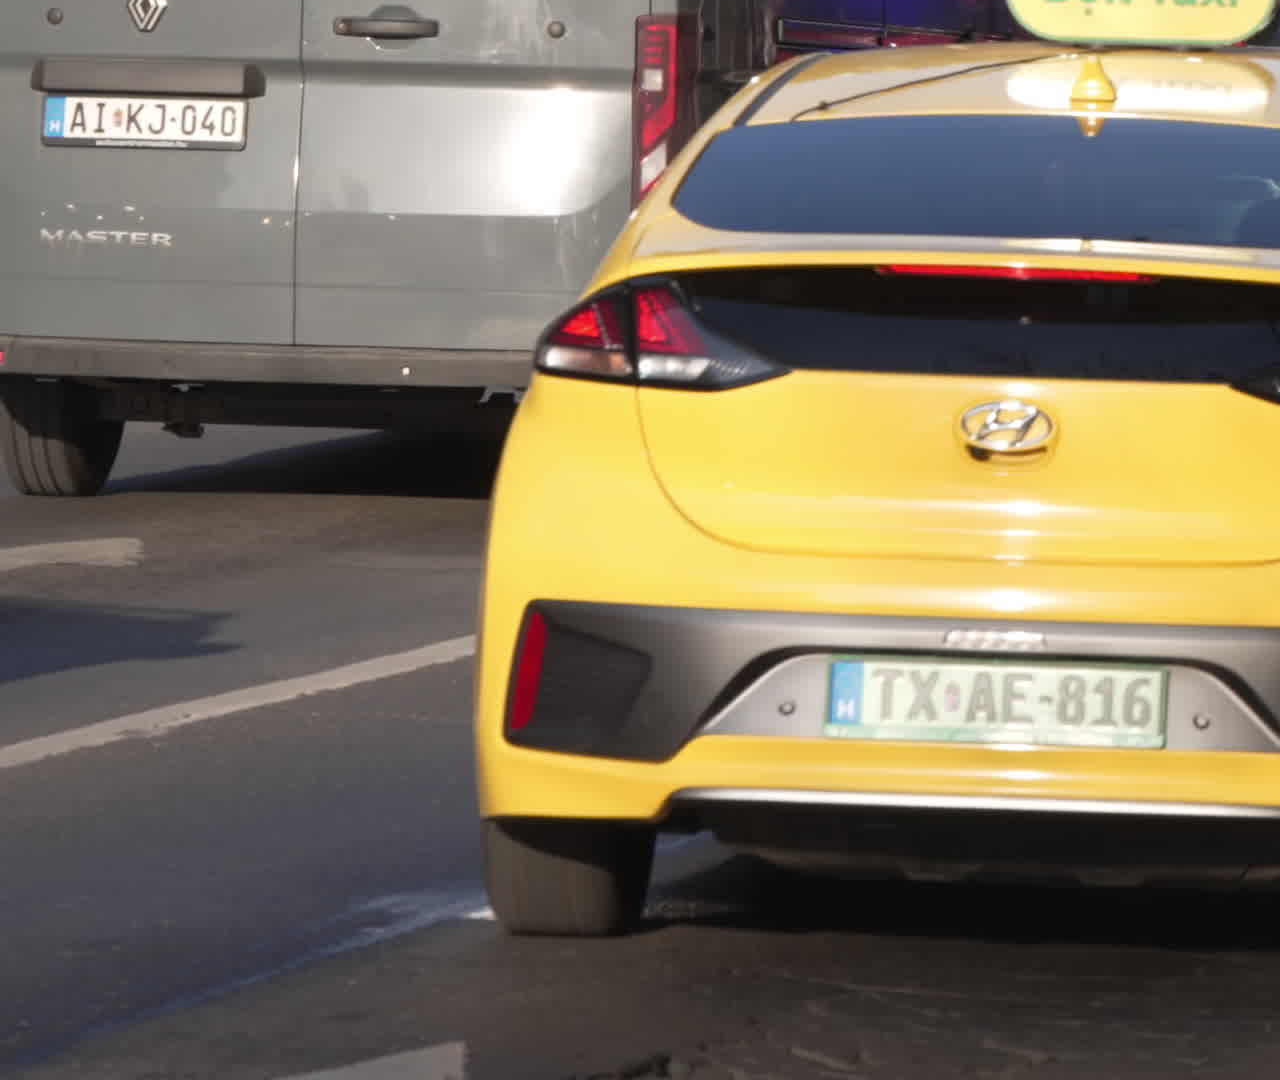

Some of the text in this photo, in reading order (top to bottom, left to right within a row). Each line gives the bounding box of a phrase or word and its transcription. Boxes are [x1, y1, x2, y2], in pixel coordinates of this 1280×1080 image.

[69, 101, 106, 134] AI
[39, 227, 174, 248] MASTER
[871, 668, 940, 722] TX
[963, 671, 1153, 728] AE-816
